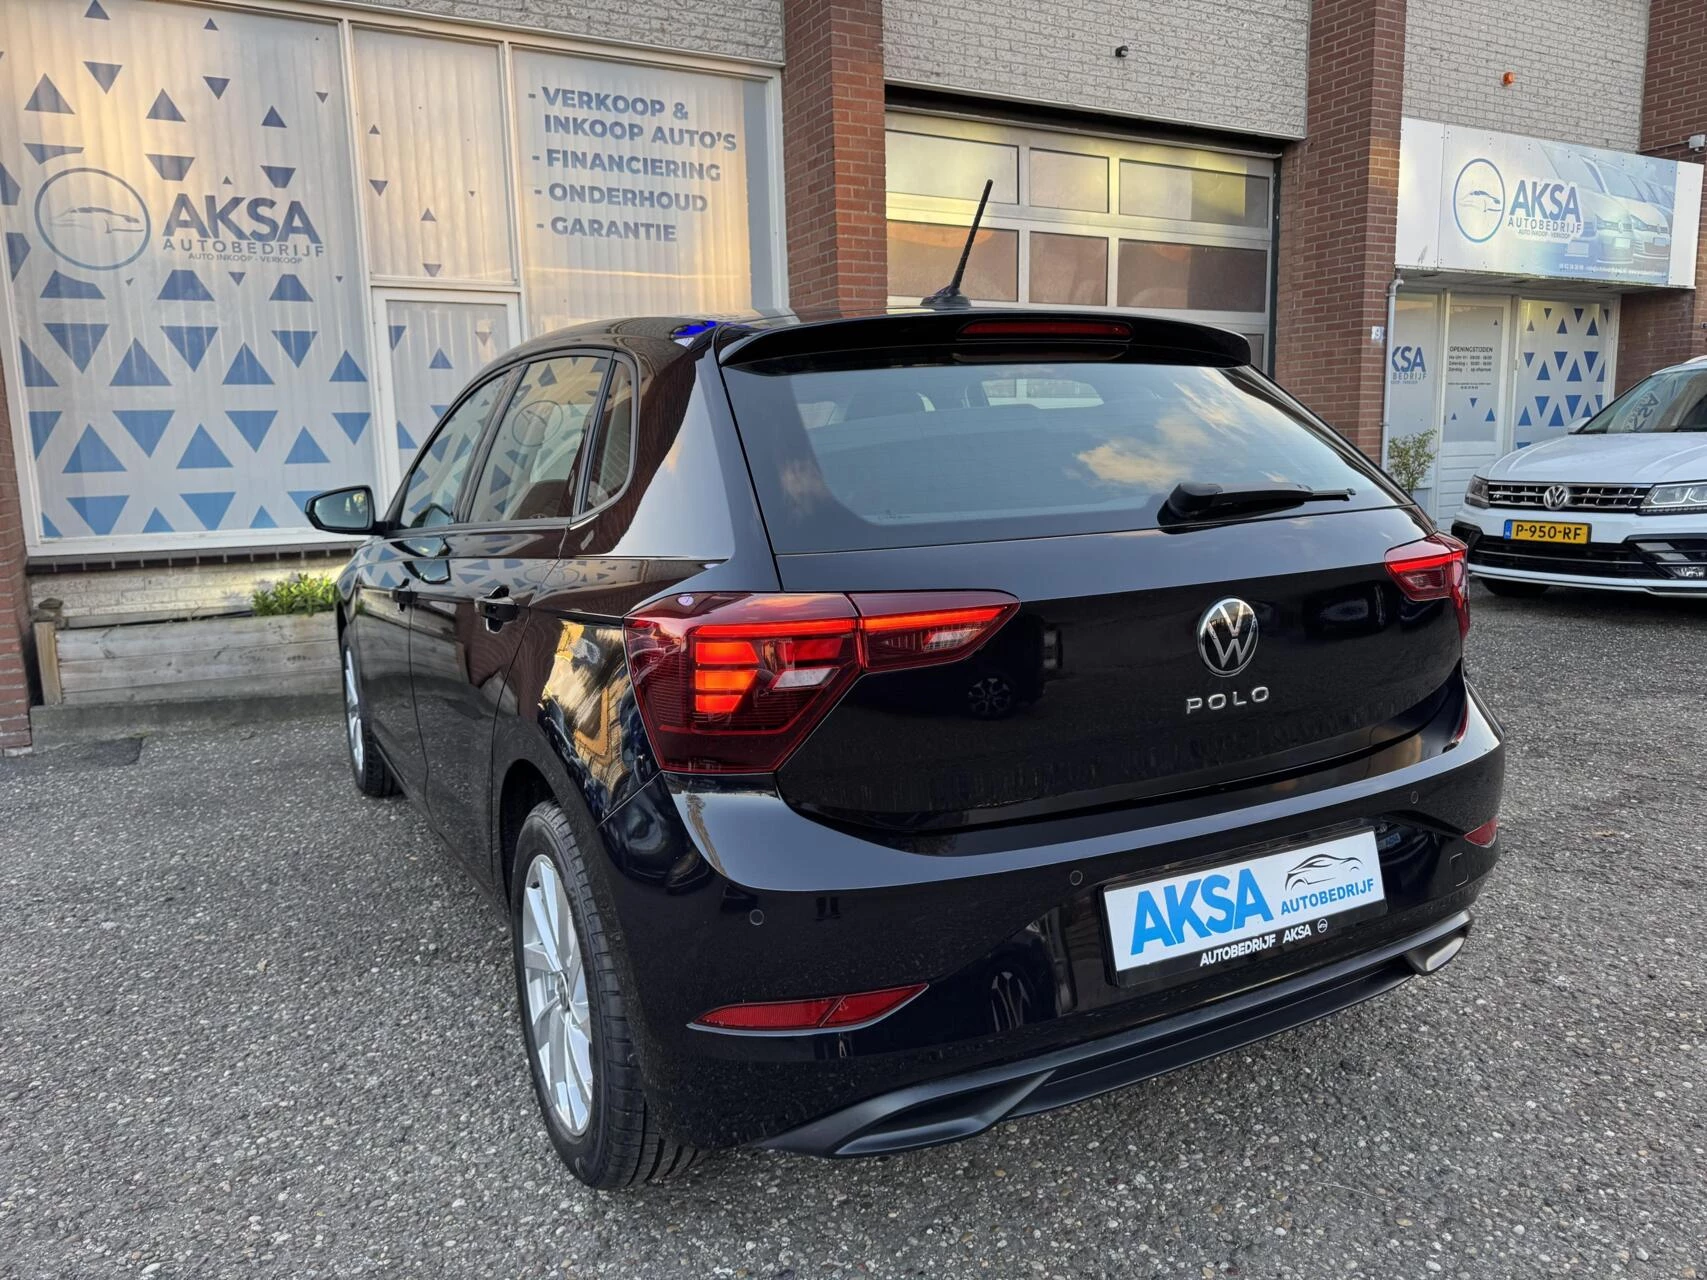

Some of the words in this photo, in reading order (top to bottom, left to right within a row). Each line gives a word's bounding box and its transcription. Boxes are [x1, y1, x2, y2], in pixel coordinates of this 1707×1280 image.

[541, 86, 666, 117] VERKOOP
[672, 102, 689, 121] &
[544, 114, 644, 141] INKOOP
[651, 126, 737, 151] AUTO'S
[546, 148, 721, 182] FINANCIERING
[548, 182, 708, 212] ONDERHOUD
[1509, 179, 1581, 223] AKSA
[162, 193, 322, 244] AKSA
[550, 216, 677, 242] GARANTIE
[1507, 217, 1582, 234] AUTOBEDRIJF
[162, 238, 324, 257] AUTOBEDRIJF
[188, 252, 214, 261] AUTO
[216, 253, 253, 263] INKOOP
[260, 256, 303, 264] VERKOOP
[1392, 346, 1427, 373] KSA
[1392, 373, 1427, 381] BEDRIJF
[1515, 523, 1583, 541] P-950-RF
[1186, 686, 1269, 714] POLO
[1130, 868, 1274, 955] AKSA
[1280, 878, 1374, 915] AUTOBEDRIJF
[1199, 934, 1276, 967] AUTOBEDRIJF
[1282, 924, 1312, 945] AKSA
